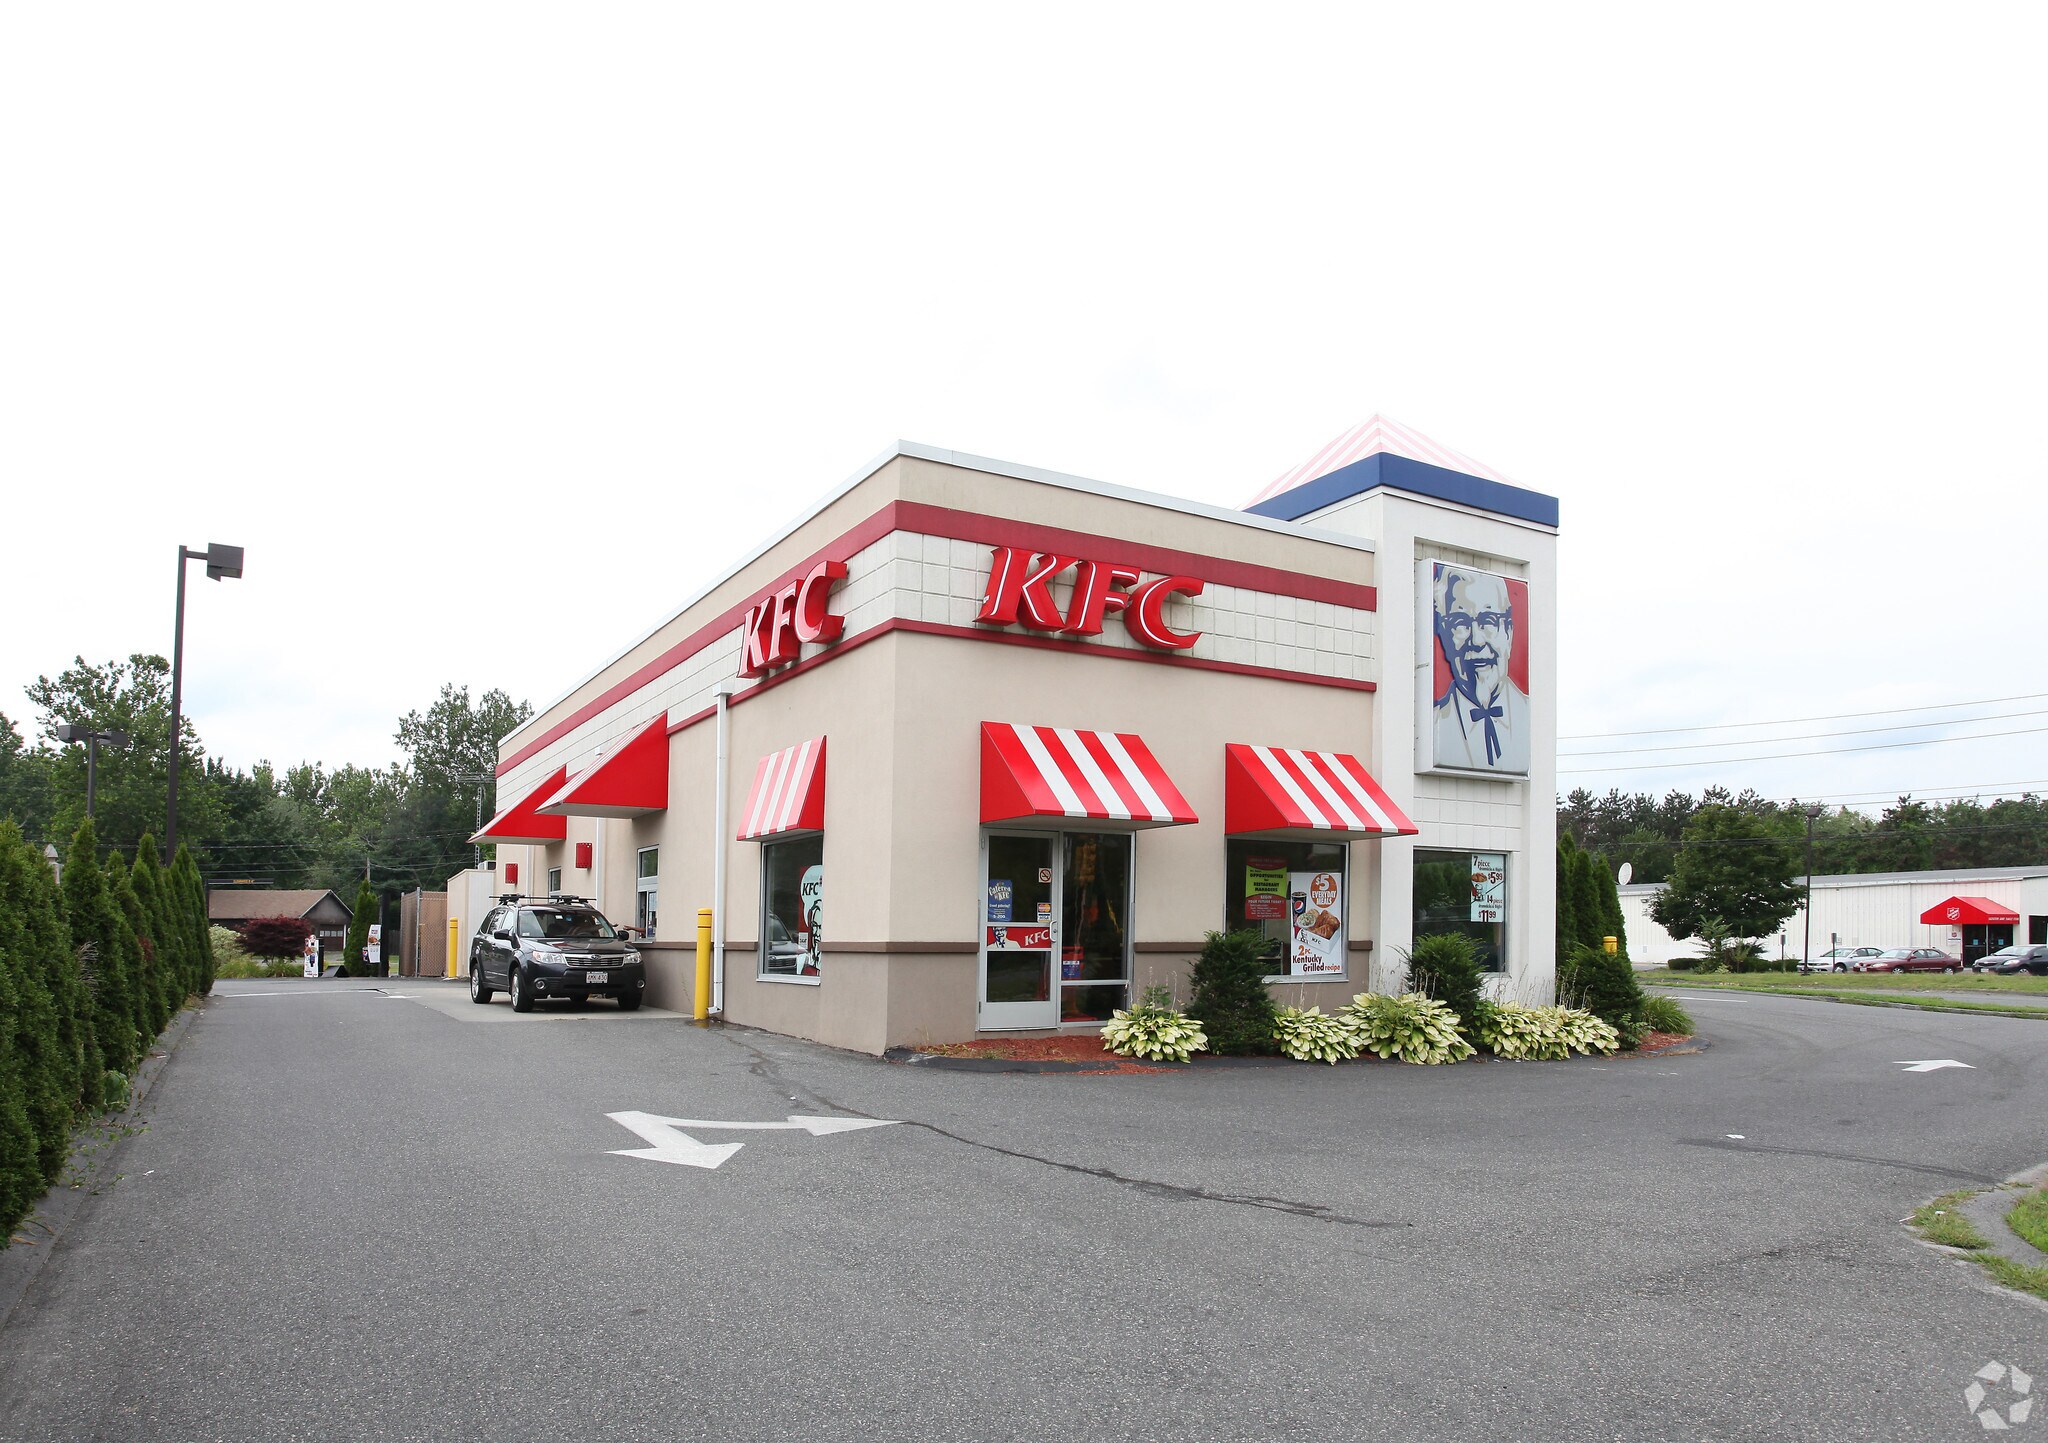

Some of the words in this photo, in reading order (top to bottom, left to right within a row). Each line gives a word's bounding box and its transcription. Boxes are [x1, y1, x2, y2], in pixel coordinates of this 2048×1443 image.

[972, 546, 1205, 649] KFC
[736, 560, 848, 679] KFC
[1474, 856, 1478, 866] 7
[1478, 860, 1490, 868] piece
[1316, 874, 1330, 890] $5
[802, 882, 818, 896] KFC
[1487, 895, 1493, 903] 14
[1025, 929, 1049, 946] KFC
[1298, 945, 1305, 956] 2
[1293, 954, 1322, 965] Kentucky
[1303, 963, 1325, 972] Grilled
